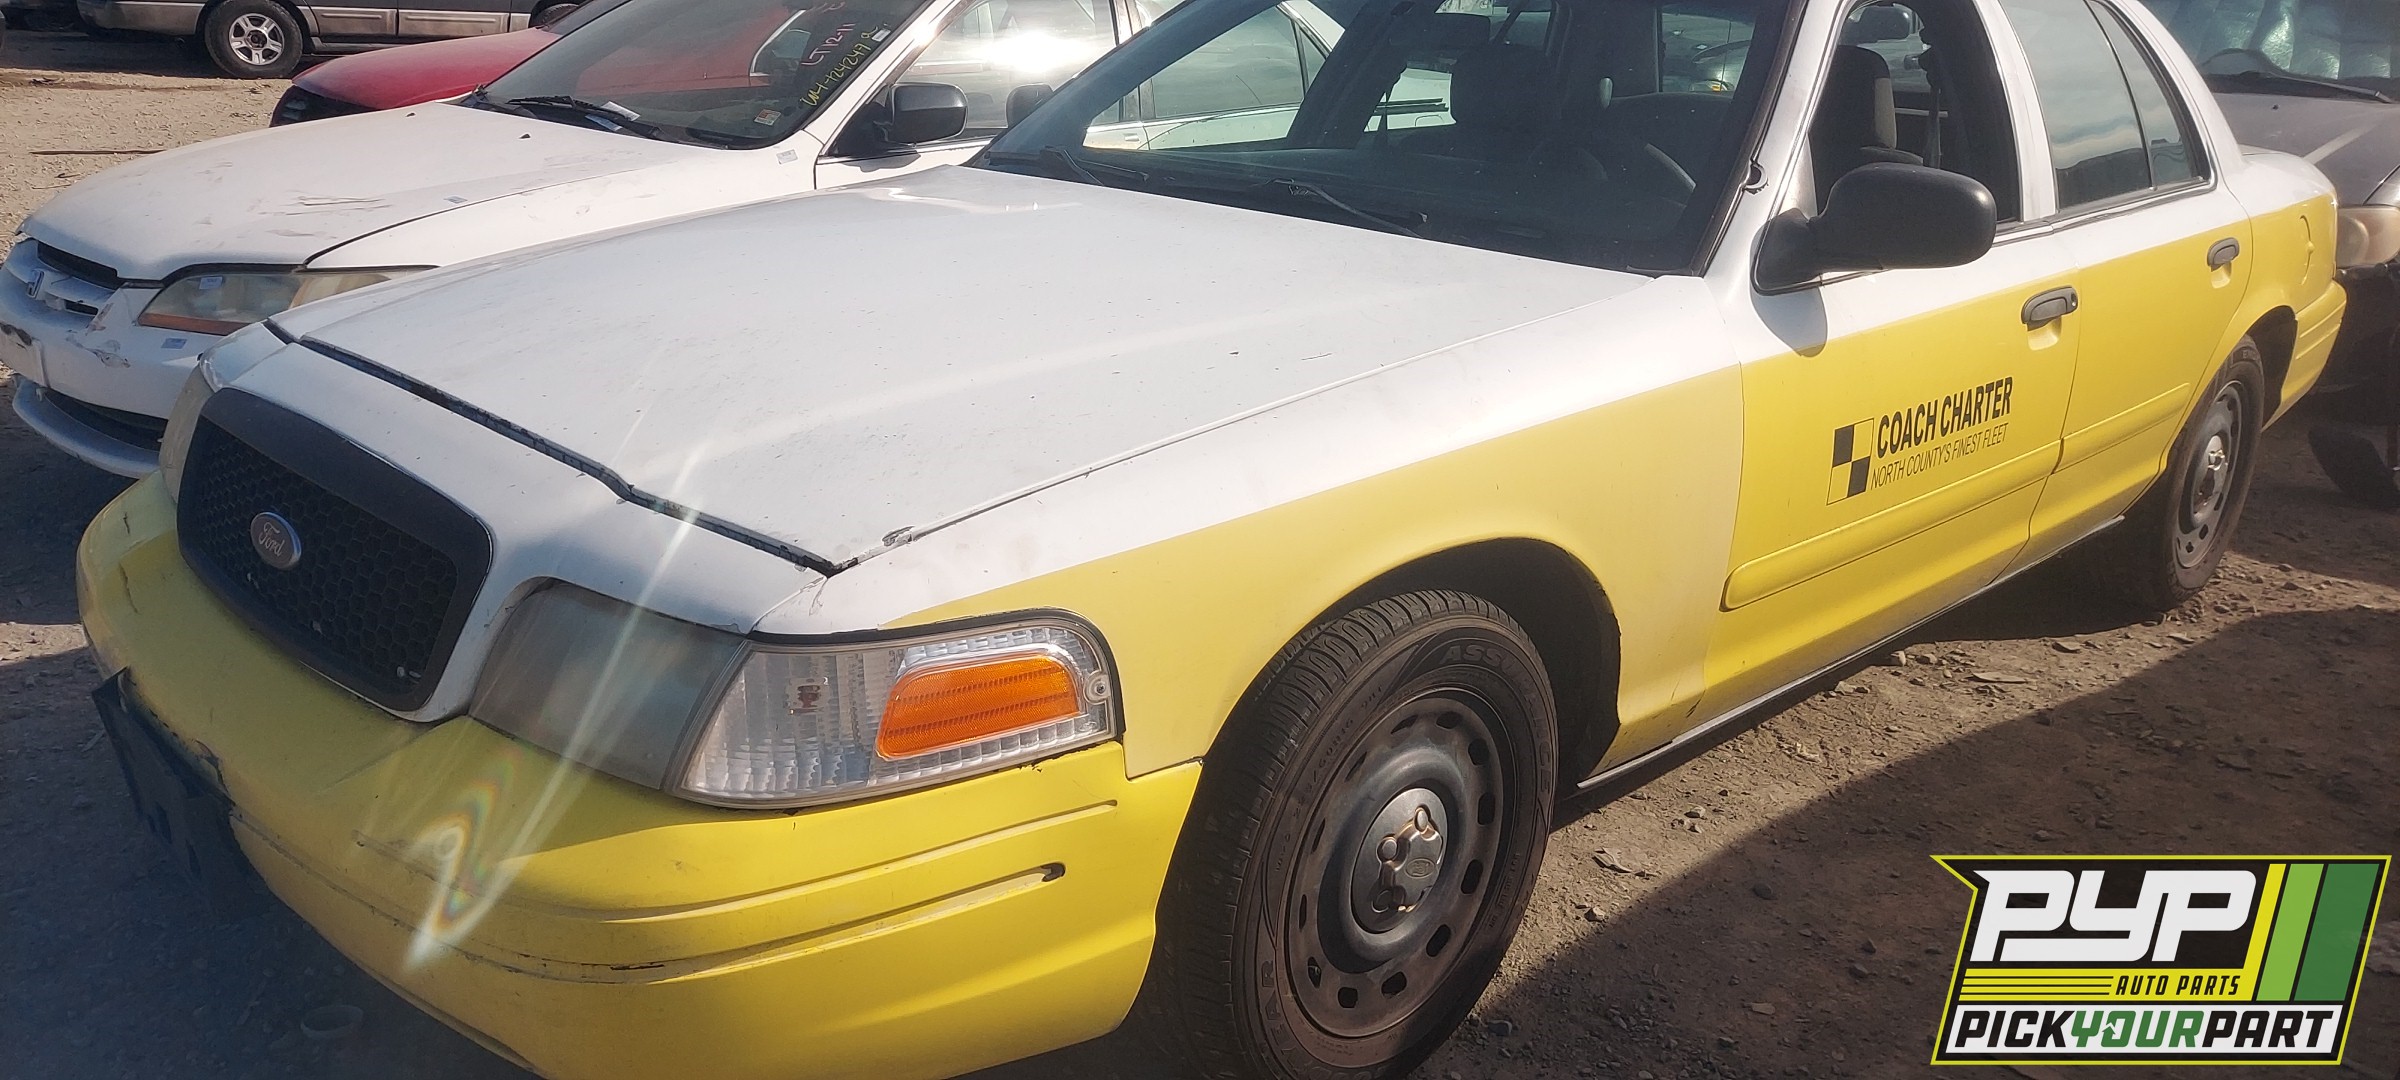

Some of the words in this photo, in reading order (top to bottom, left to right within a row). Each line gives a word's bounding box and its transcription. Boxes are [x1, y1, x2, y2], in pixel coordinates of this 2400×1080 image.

[1877, 399, 1938, 458] COACH
[1940, 376, 2013, 437] CHARTER
[1870, 458, 1904, 490] NORTH
[1906, 442, 1951, 476] COUNTY'S
[1951, 431, 1982, 461] FINEST
[1982, 422, 2009, 448] FLEET
[258, 522, 286, 557] Ford
